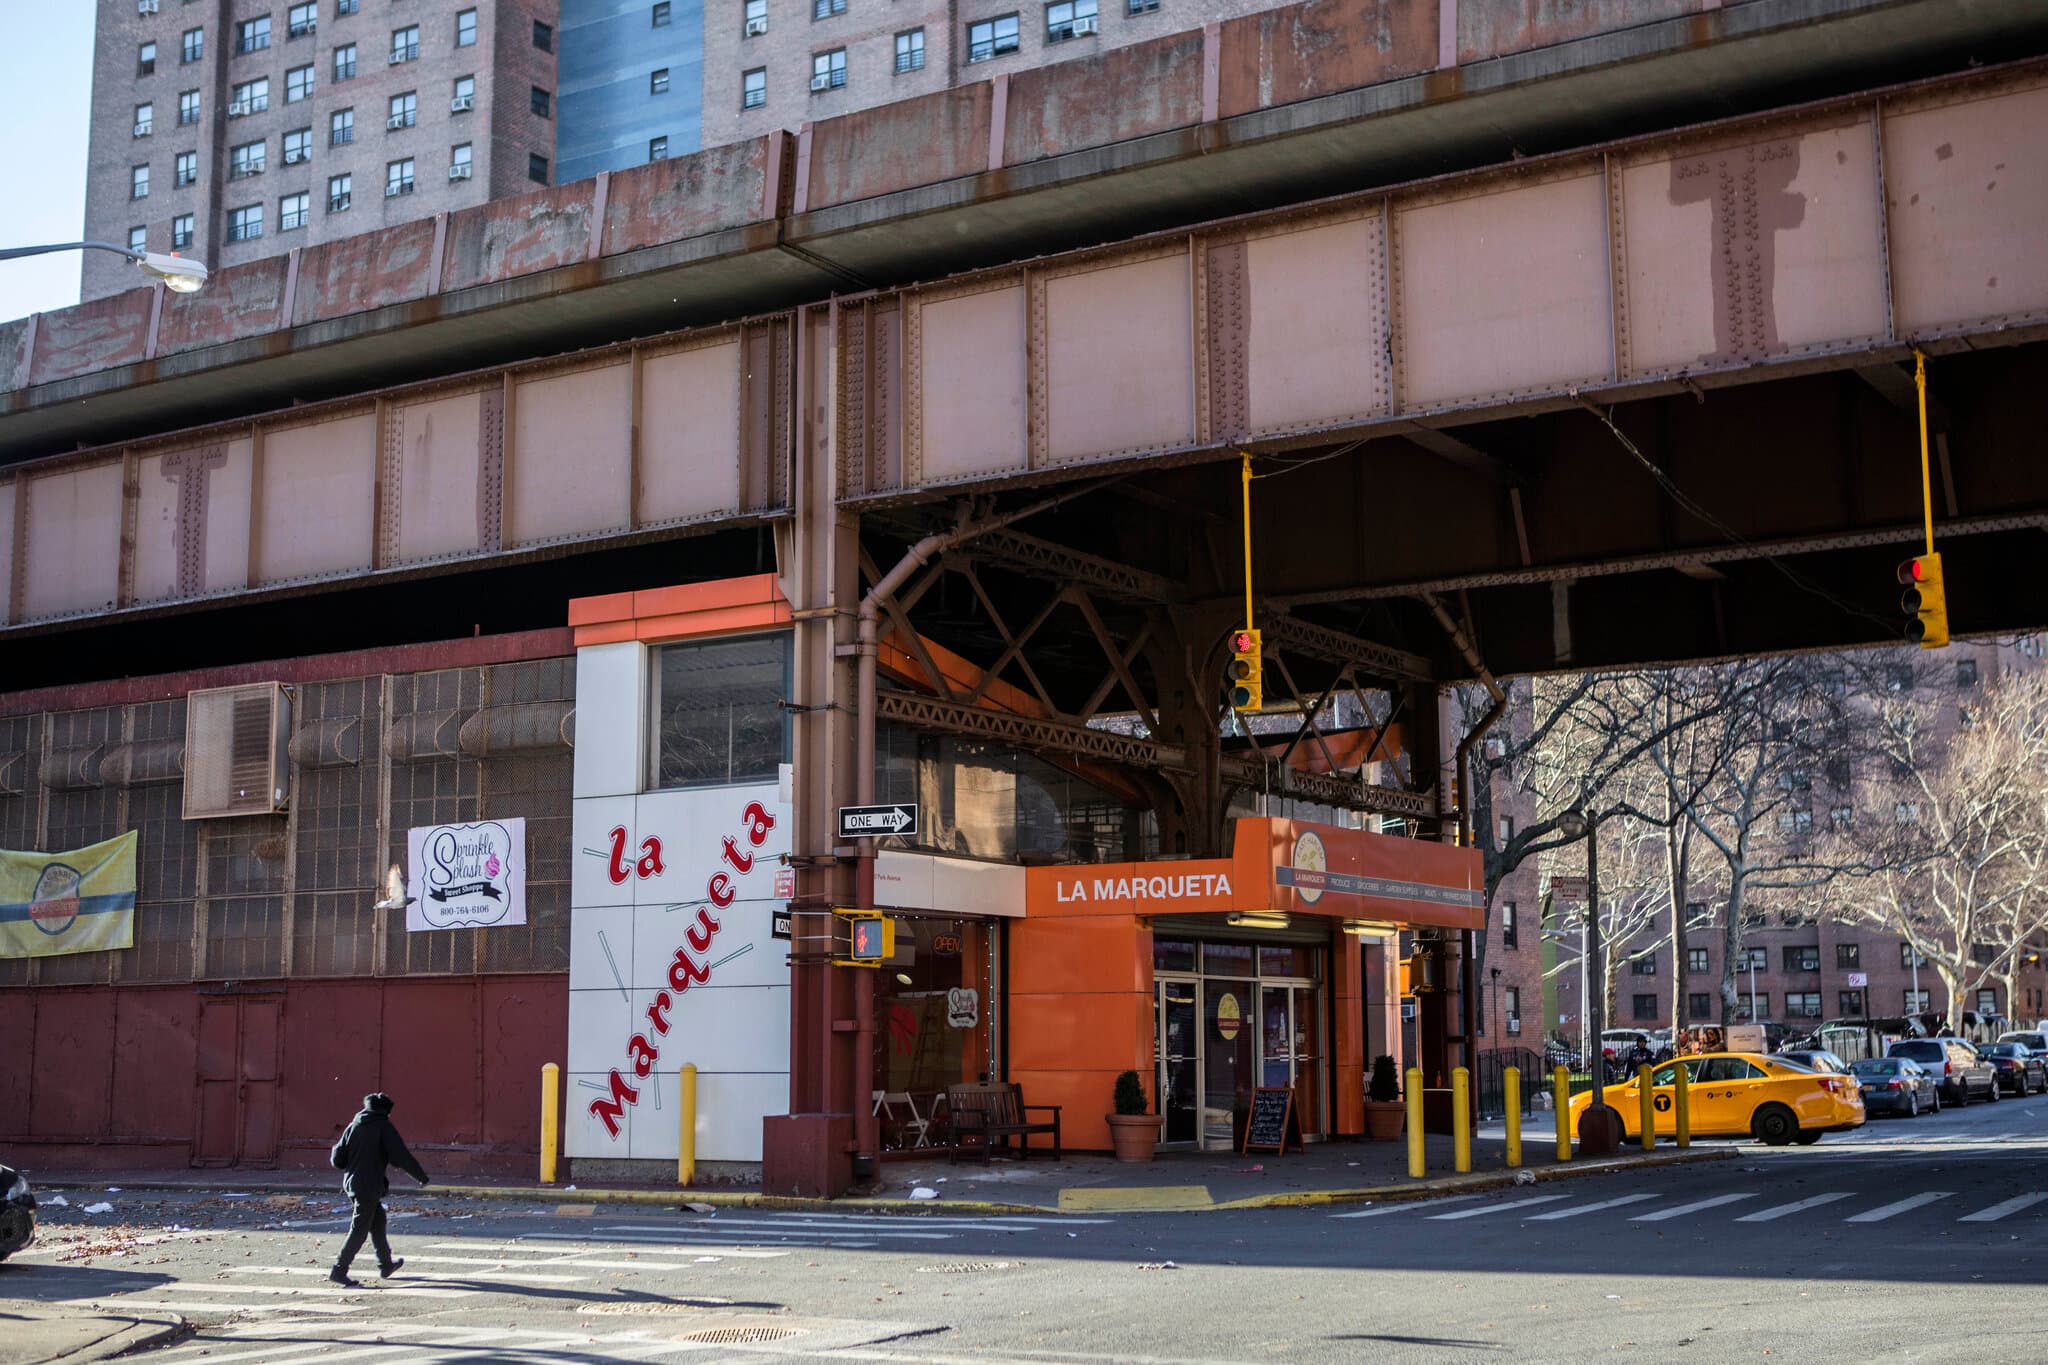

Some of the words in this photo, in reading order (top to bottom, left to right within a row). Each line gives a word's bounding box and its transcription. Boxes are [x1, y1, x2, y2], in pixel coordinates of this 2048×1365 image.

[850, 815, 872, 827] ONE
[881, 814, 905, 826] WAY
[431, 832, 494, 872] Sprinkle
[608, 824, 667, 886] la
[444, 887, 461, 897] Sweet
[462, 884, 484, 894] Shoppe
[1057, 880, 1087, 902] LA
[1094, 873, 1232, 901] MARQUETA
[440, 904, 490, 916] 800-764-6106
[779, 920, 791, 932] ON
[934, 935, 960, 952] OPEN
[588, 800, 777, 1142] Marqueta
[1657, 1097, 1667, 1110] T
